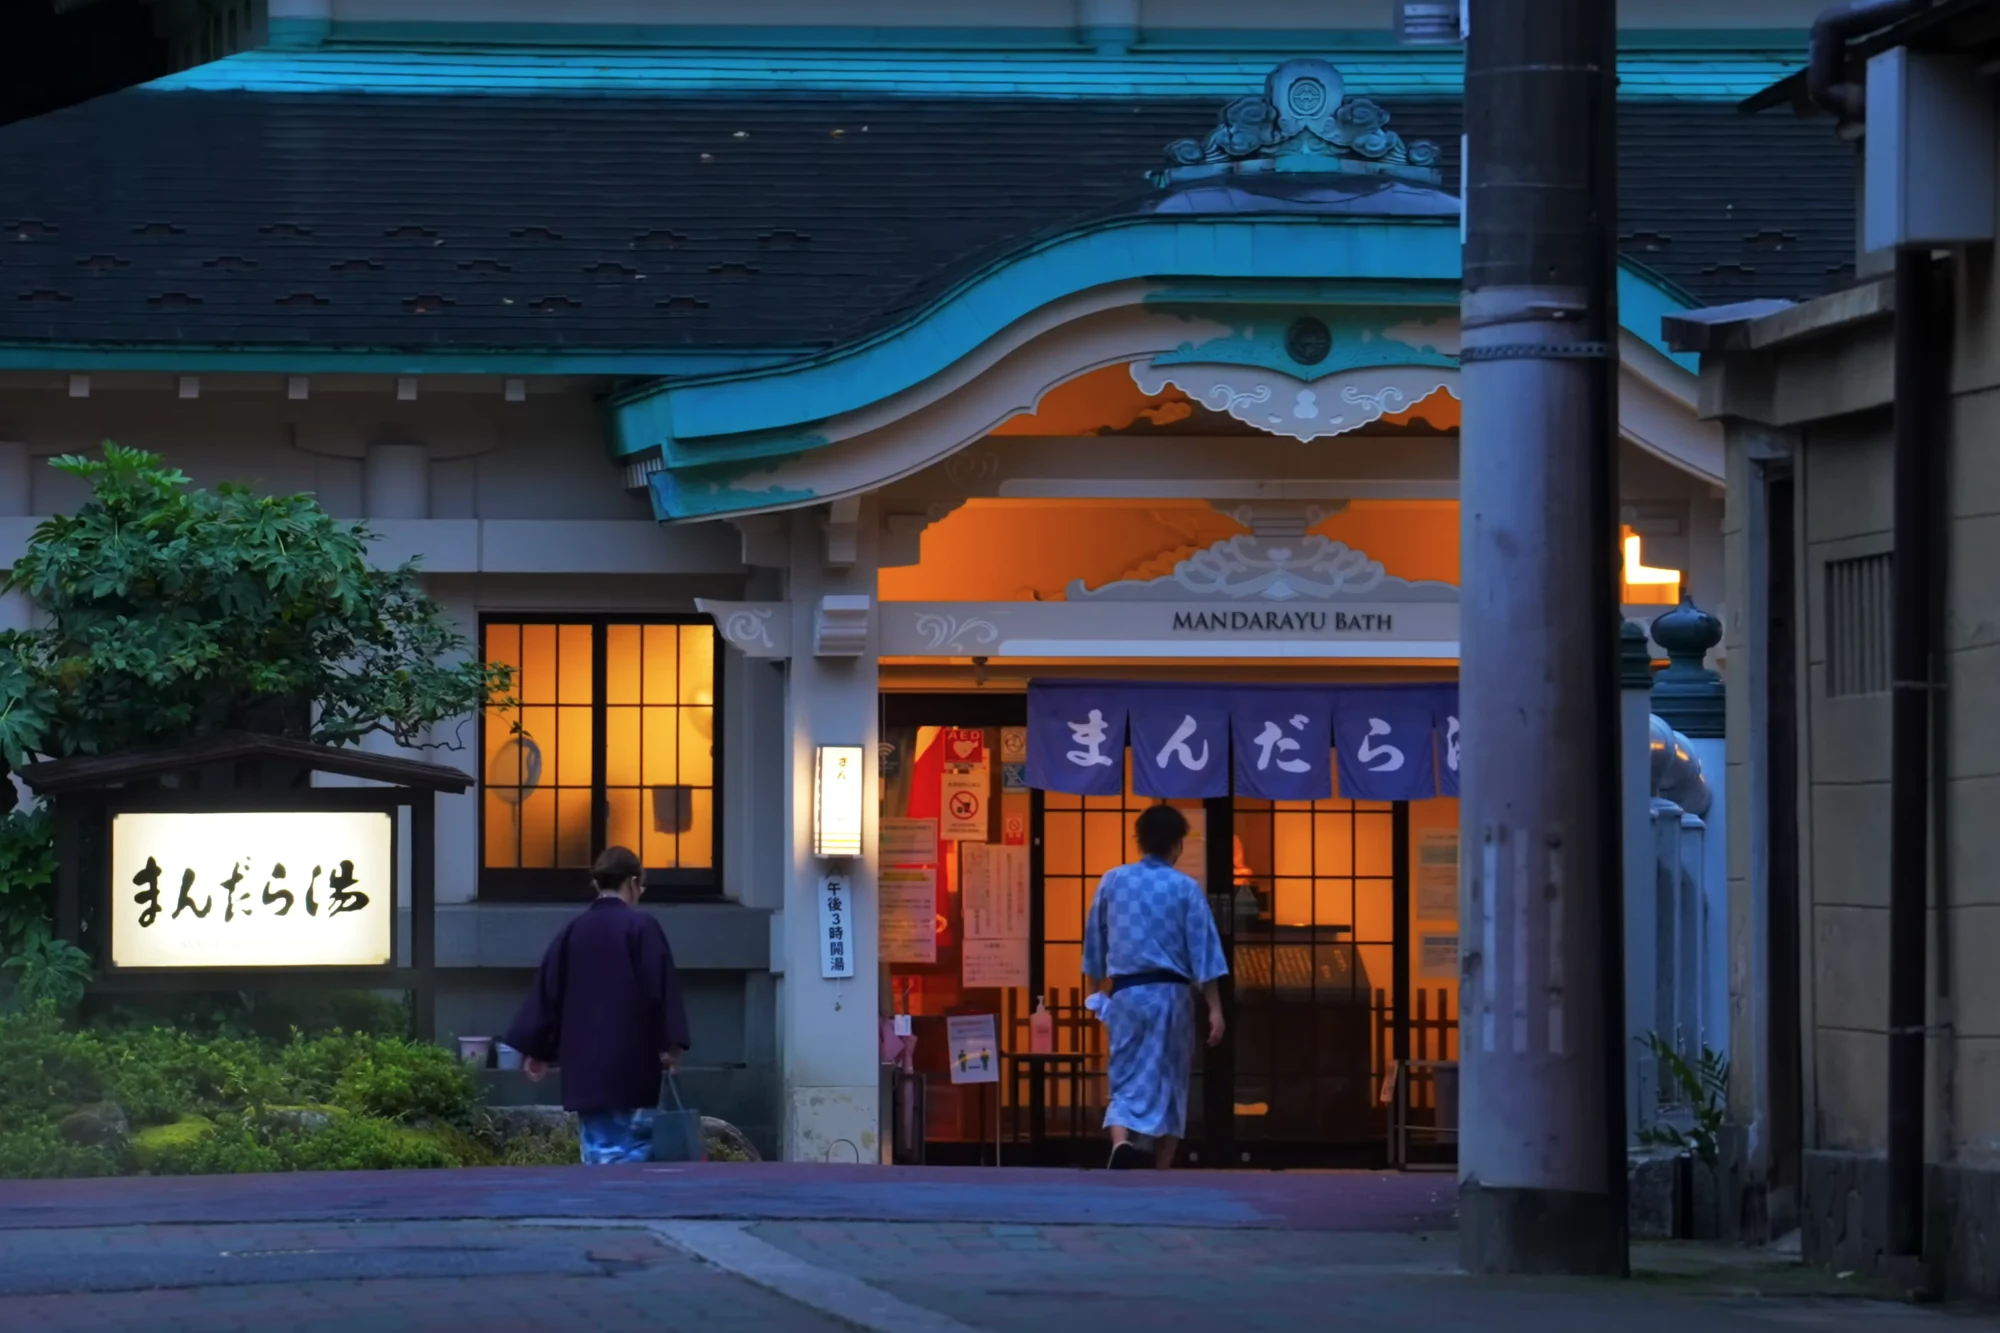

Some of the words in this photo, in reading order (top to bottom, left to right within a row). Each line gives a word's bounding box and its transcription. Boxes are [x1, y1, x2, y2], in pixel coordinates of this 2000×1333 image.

[1172, 610, 1327, 632] MANDARAYU
[947, 730, 980, 740] AED
[1066, 709, 1460, 774] まんだら
[132, 855, 371, 929] まんだら湯
[826, 881, 846, 972] 午後3時開湯
